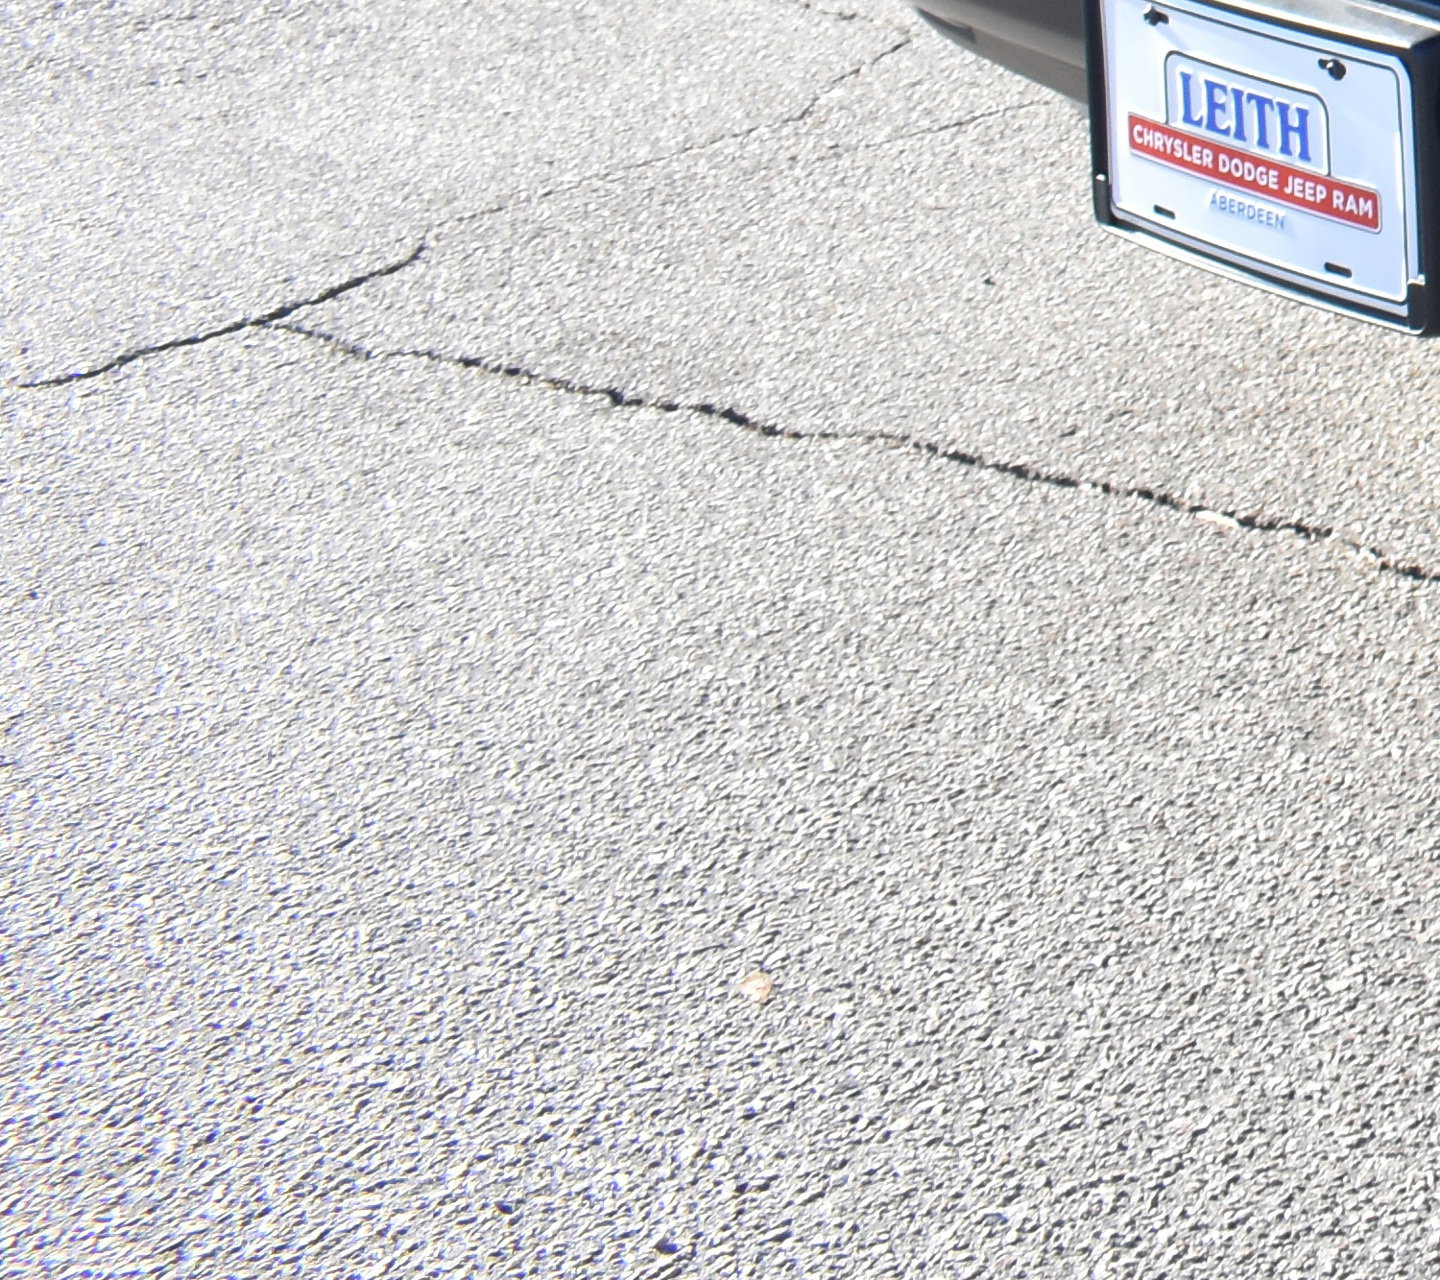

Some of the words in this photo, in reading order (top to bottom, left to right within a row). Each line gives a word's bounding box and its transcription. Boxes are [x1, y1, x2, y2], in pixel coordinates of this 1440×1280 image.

[1177, 71, 1312, 163] LEITH
[1133, 124, 1213, 169] CHRYSLER
[1218, 152, 1280, 191] DODGE
[1284, 173, 1327, 204] JEEP
[1332, 189, 1375, 218] RAM
[1209, 192, 1286, 230] ABERDEEN
